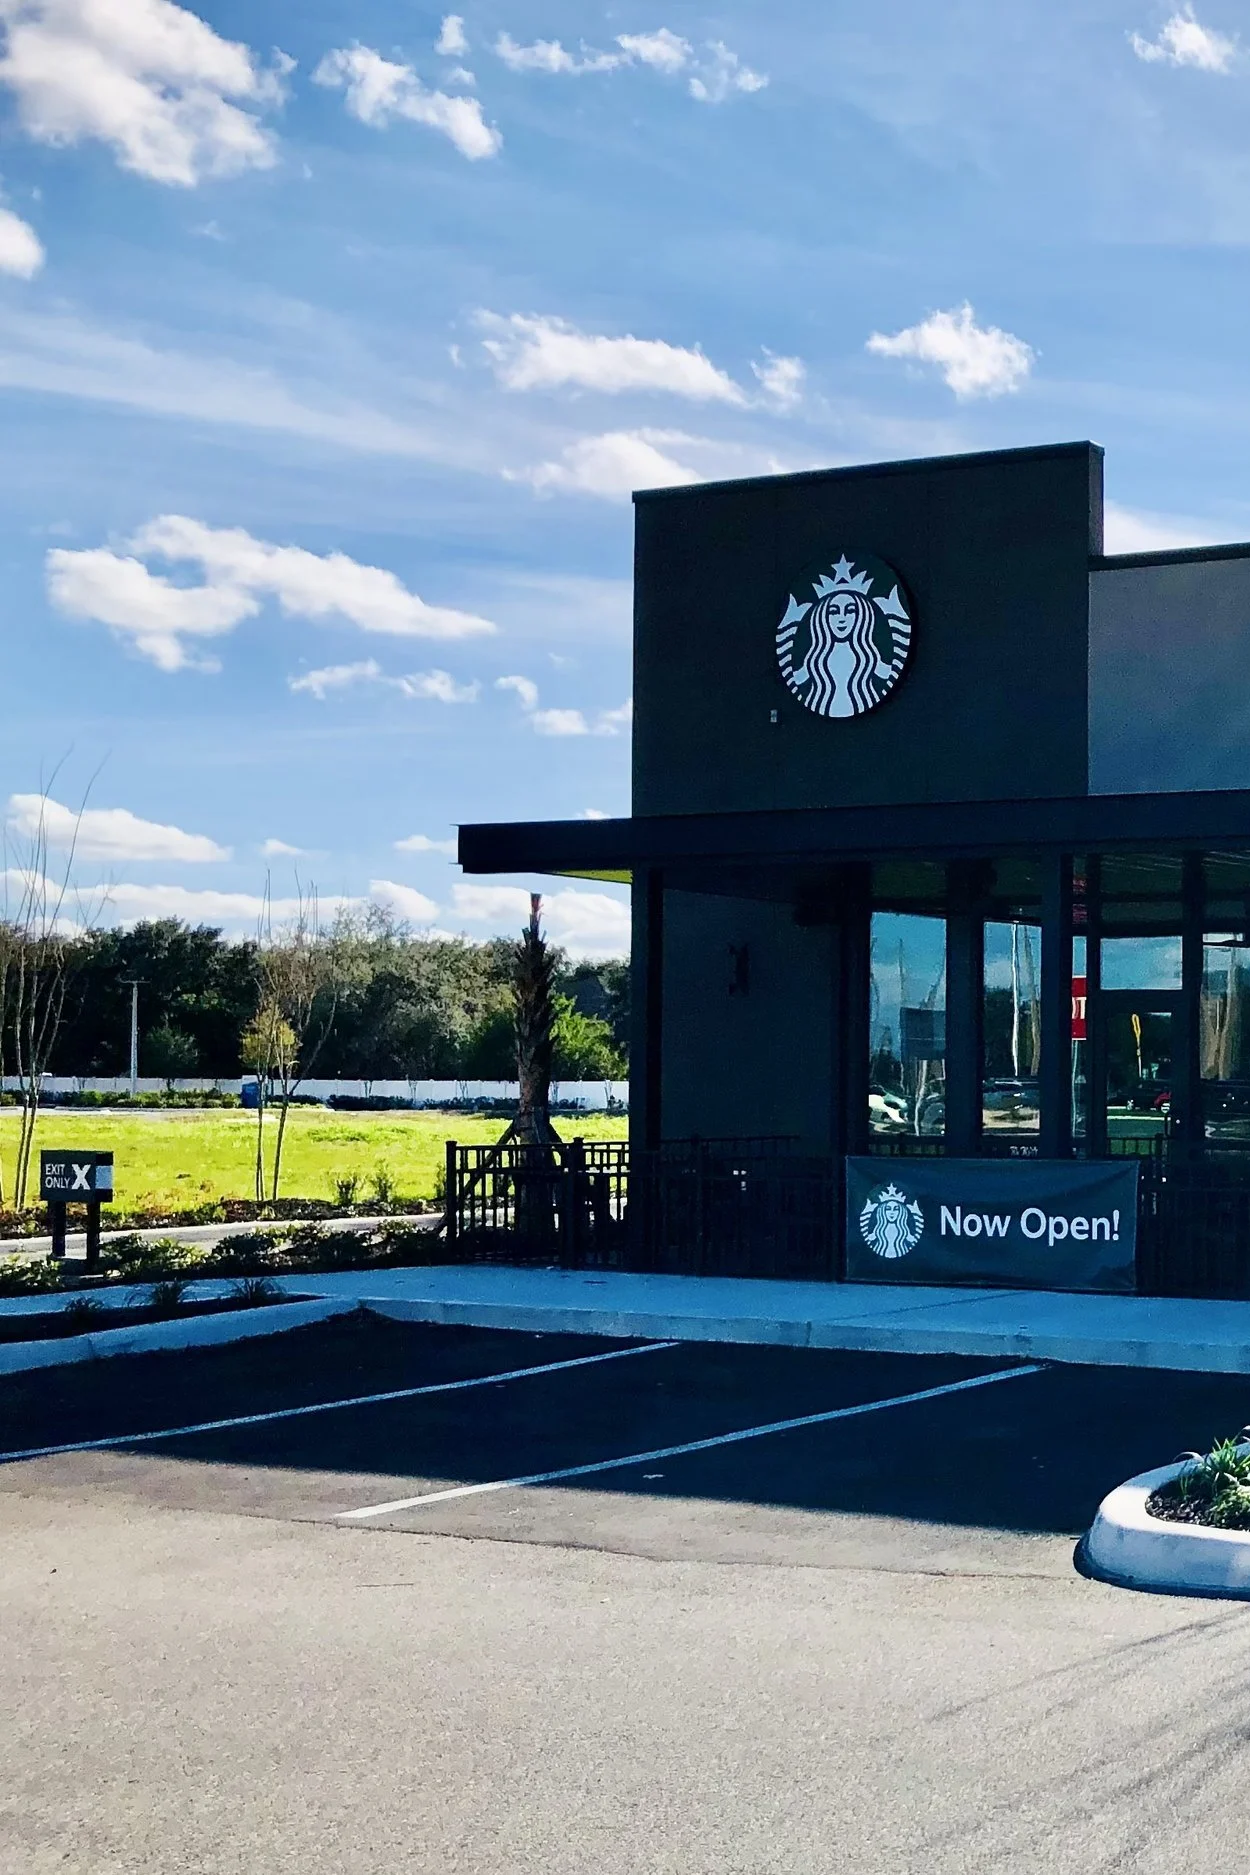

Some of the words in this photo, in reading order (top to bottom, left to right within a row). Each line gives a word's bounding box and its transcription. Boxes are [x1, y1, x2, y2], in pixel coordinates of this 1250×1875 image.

[45, 1163, 66, 1175] EXIT
[45, 1176, 70, 1189] ONLY
[940, 1205, 1010, 1237] Now
[1020, 1207, 1120, 1246] Open!
